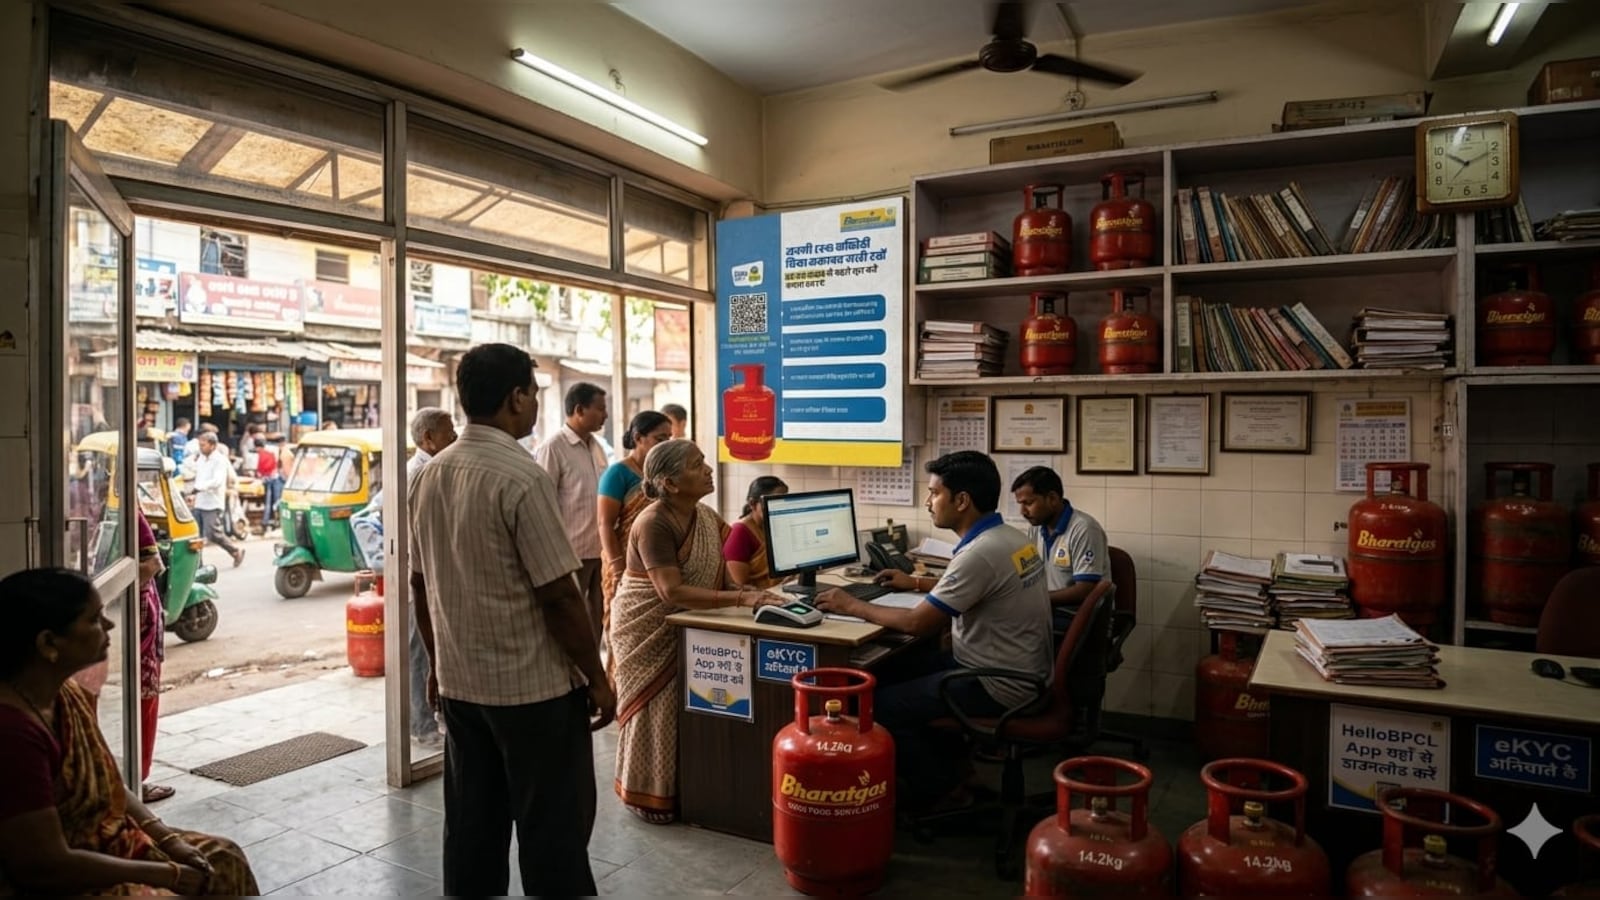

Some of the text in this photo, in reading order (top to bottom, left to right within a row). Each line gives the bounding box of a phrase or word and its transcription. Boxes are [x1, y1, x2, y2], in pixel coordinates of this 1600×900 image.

[1491, 142, 1499, 151] 2
[1491, 156, 1499, 166] 3
[1491, 171, 1499, 180] 4
[1447, 184, 1488, 196] 7 6 5
[766, 648, 807, 663] eKYC
[1342, 723, 1439, 748] HelloBPCL
[1346, 742, 1382, 759] App
[1494, 738, 1572, 761] eKYC
[781, 773, 887, 806] Bharatgas
[1078, 850, 1124, 871] 14.2kg
